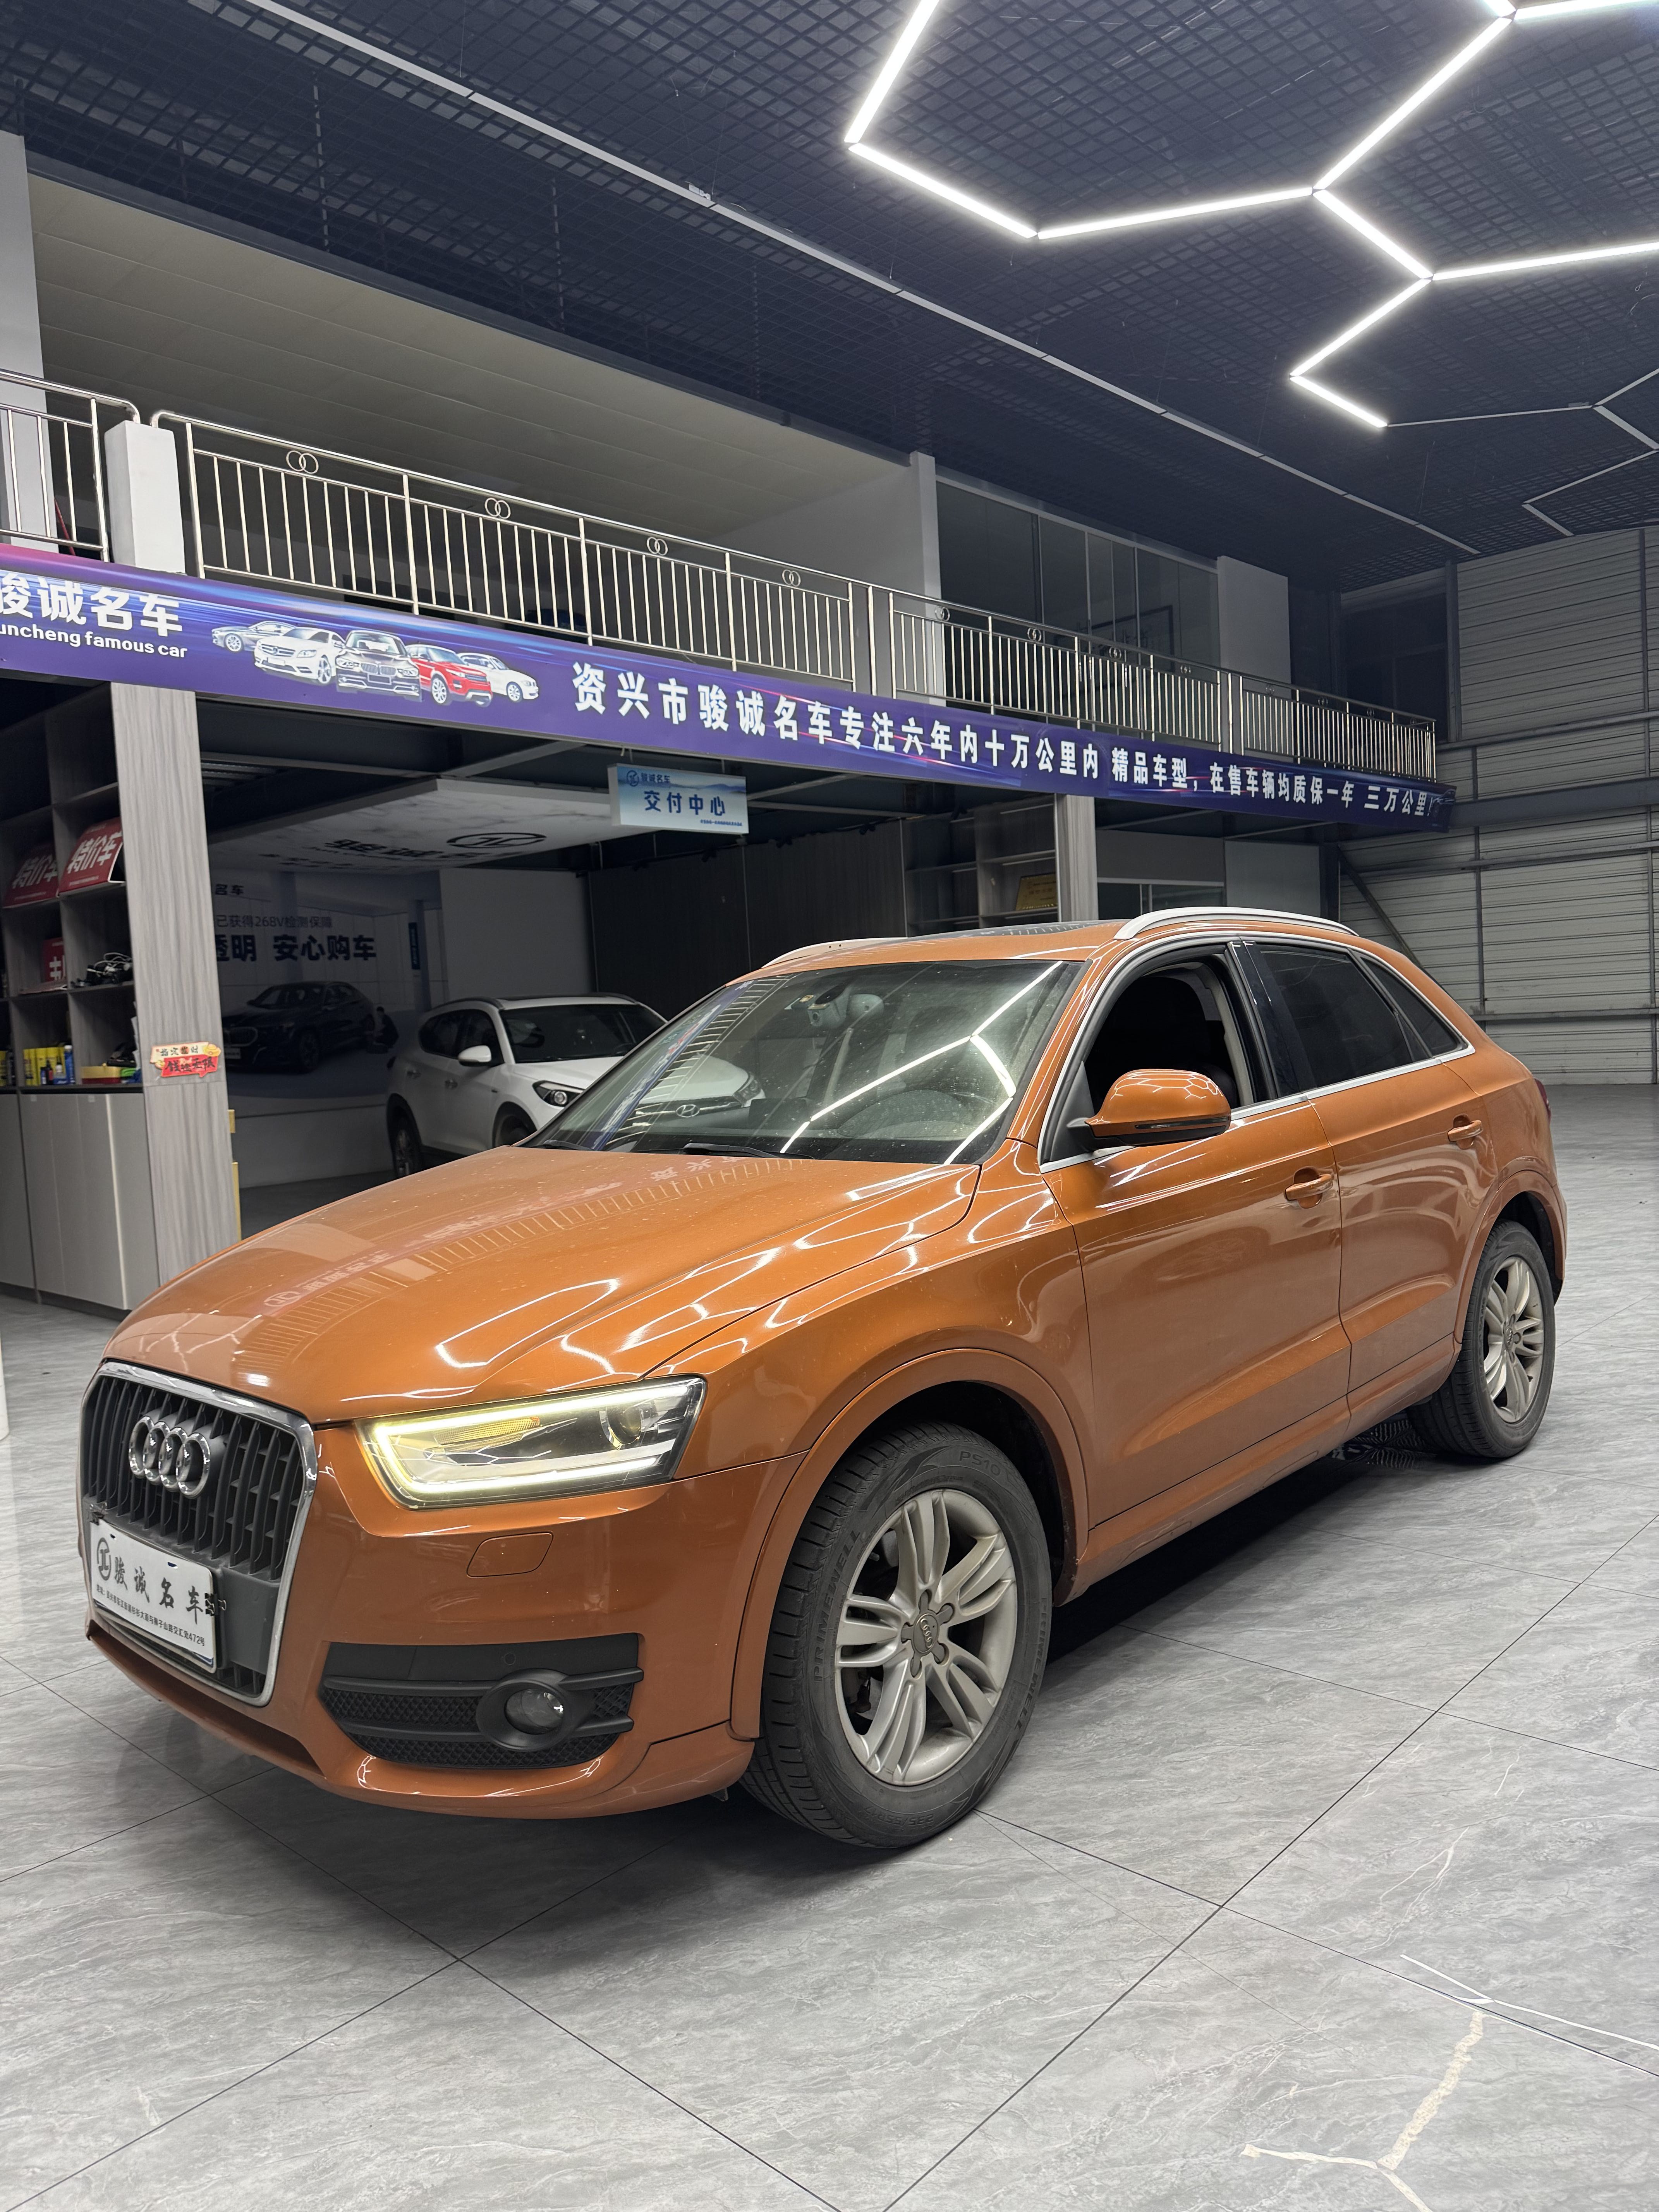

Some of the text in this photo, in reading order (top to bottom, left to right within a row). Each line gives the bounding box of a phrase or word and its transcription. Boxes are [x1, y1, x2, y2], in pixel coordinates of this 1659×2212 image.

[85, 631, 155, 654] famous
[157, 644, 188, 658] car
[572, 661, 1099, 779] 资兴市骏诚名车专注六年内十万公里内
[641, 772, 670, 783] 骏诚名车
[644, 790, 725, 816] 交付中心
[273, 934, 376, 962] 安心购车
[959, 1451, 1001, 1476] PS10
[114, 1556, 204, 1625] 骏诚名车
[814, 1530, 860, 1682] PRIMEWELL
